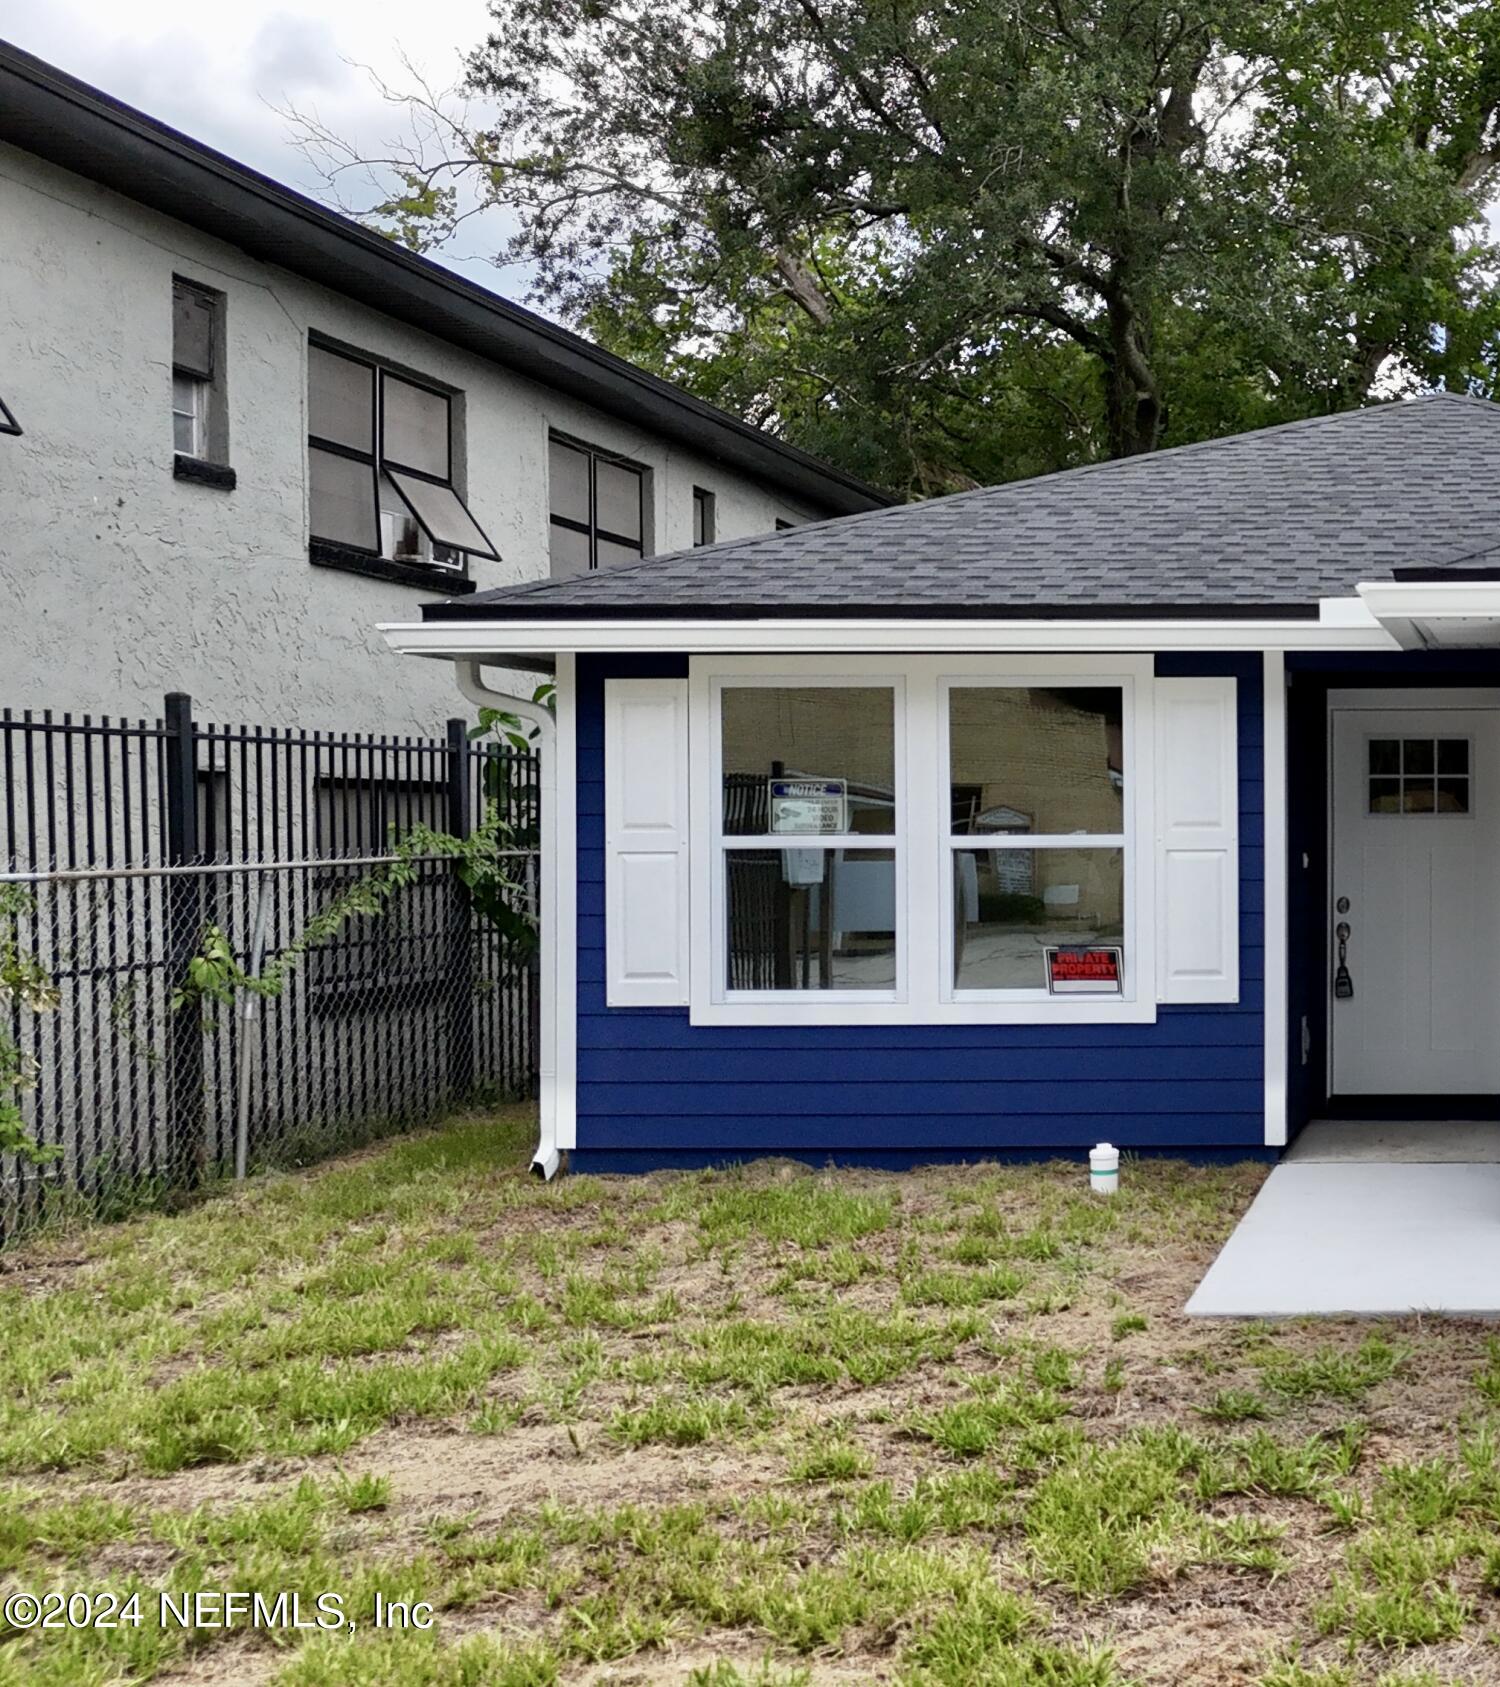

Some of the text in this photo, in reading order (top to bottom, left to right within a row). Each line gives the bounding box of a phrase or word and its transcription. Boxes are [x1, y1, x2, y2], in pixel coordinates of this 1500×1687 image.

[788, 783, 827, 796] NOTICE
[1055, 952, 1110, 963] PRIVATE
[1052, 963, 1117, 974] PROPERTY
